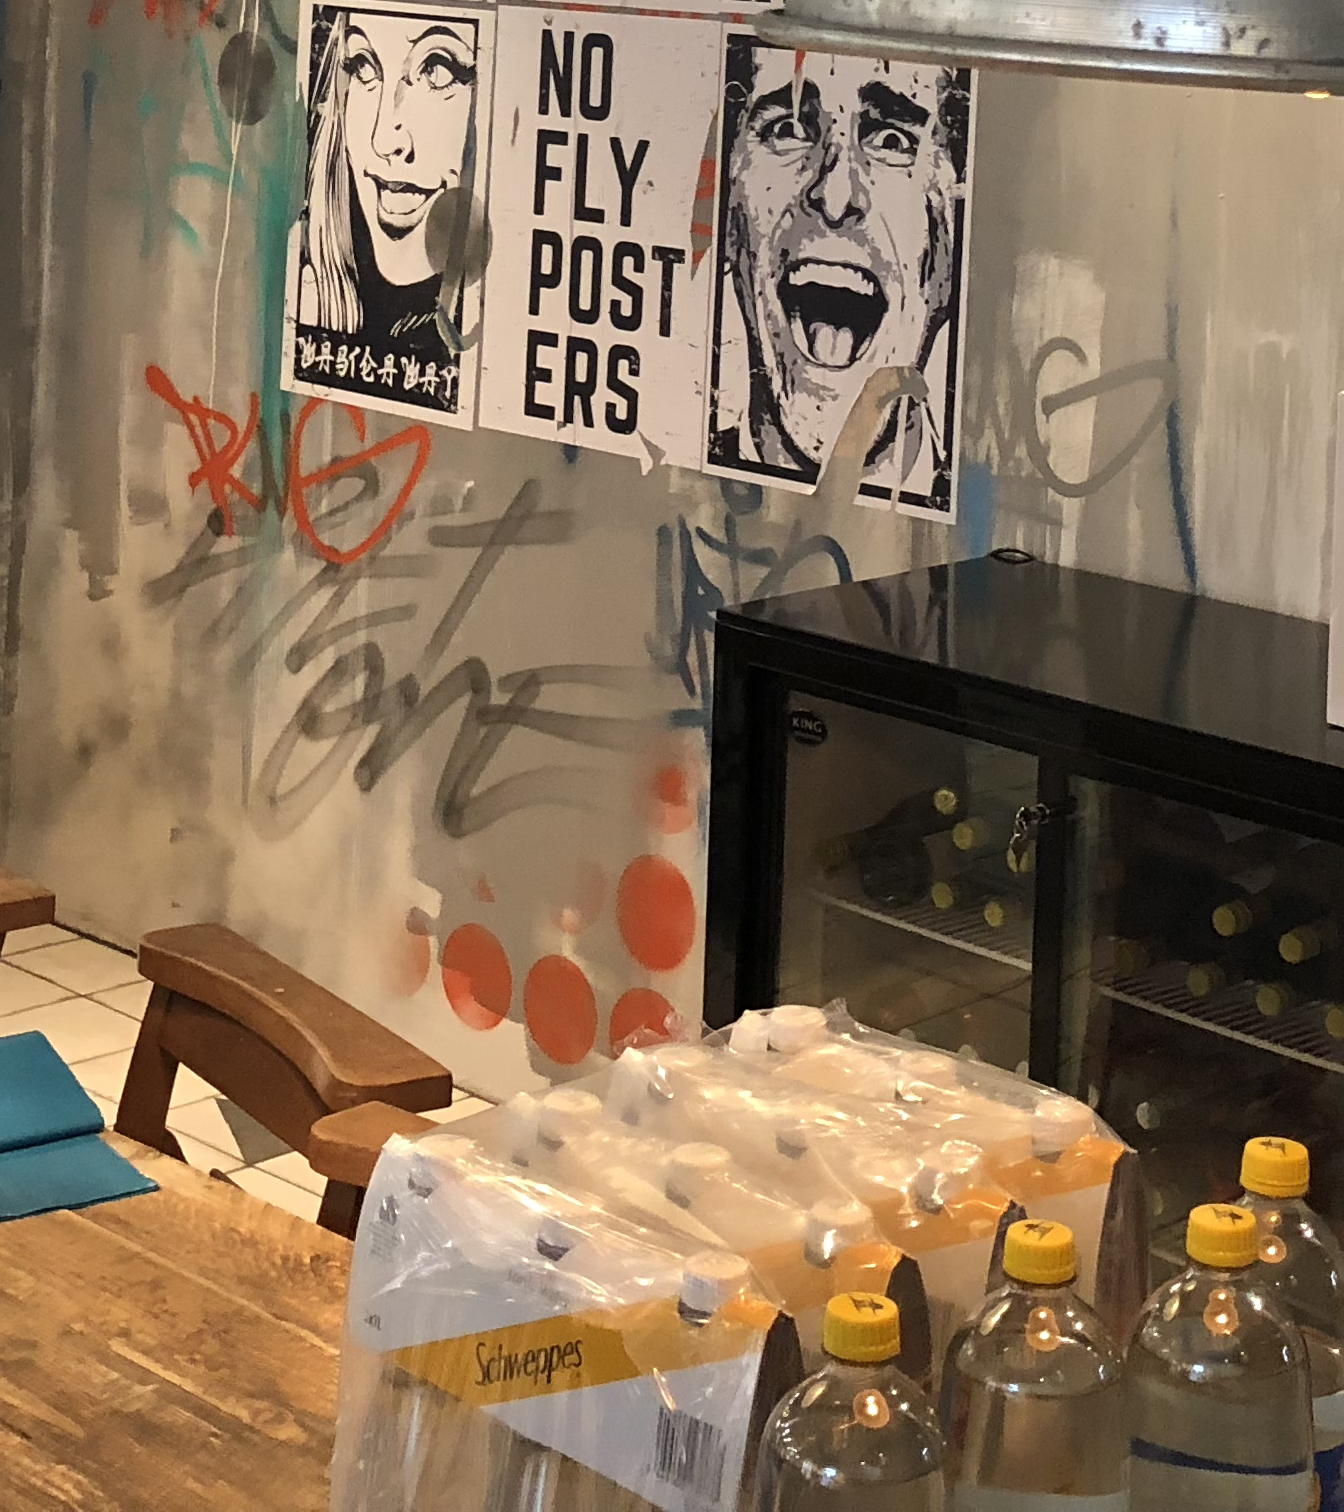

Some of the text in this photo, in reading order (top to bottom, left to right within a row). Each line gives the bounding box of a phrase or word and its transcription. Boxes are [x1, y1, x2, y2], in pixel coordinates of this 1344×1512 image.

[537, 28, 614, 121] NO
[533, 128, 651, 228] FLY
[528, 228, 686, 338] POST
[523, 328, 641, 436] ERS
[792, 716, 823, 733] KING
[474, 1339, 584, 1386] Schweppes
